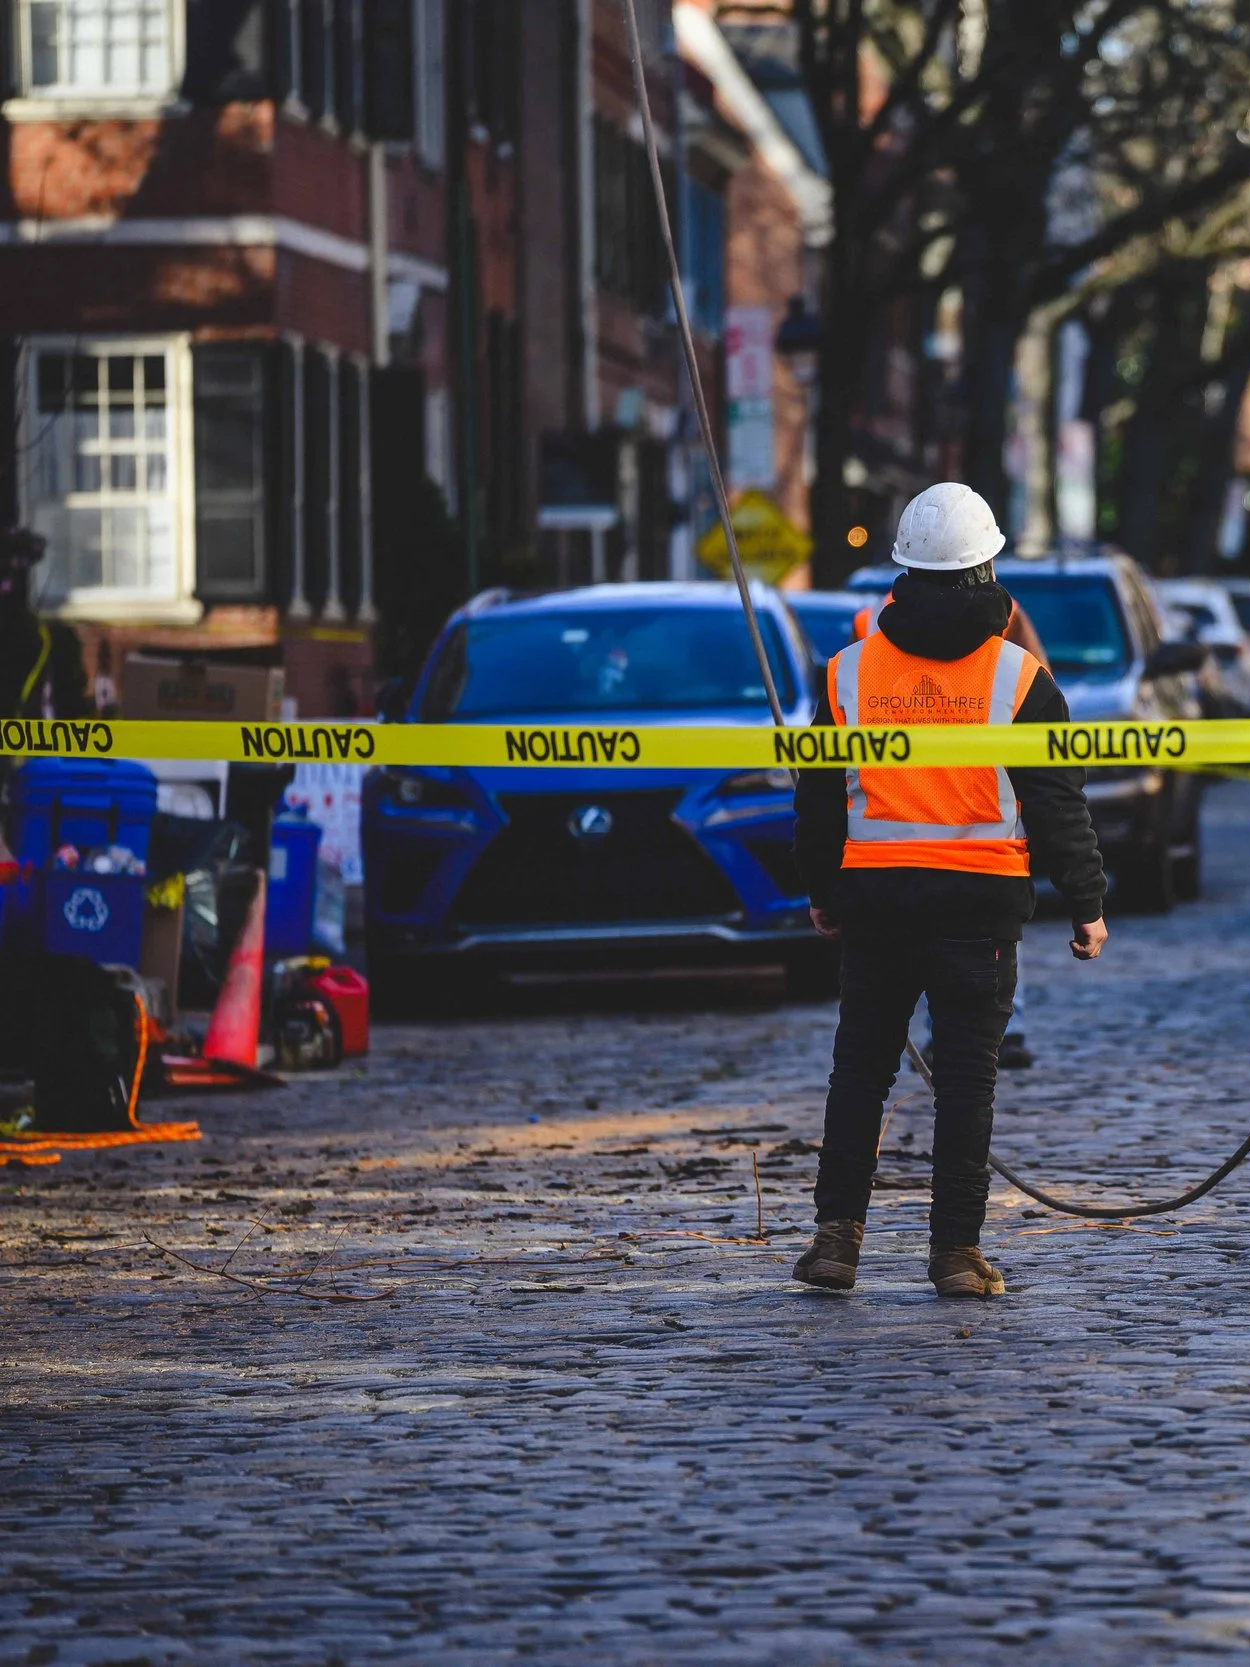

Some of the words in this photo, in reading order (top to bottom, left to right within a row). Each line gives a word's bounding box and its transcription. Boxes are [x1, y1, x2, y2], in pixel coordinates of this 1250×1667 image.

[867, 696, 936, 709] GROUND
[939, 695, 985, 710] THREE
[0, 720, 113, 752] CAUTIO
[867, 717, 893, 725] DESIGN
[895, 717, 911, 725] THAT
[912, 717, 931, 725] LIVES
[931, 717, 950, 725] WITH
[952, 717, 965, 725] THE
[241, 727, 375, 758] CAUTION
[505, 731, 641, 762] CAUTION
[774, 731, 911, 763] CAUTION
[1047, 726, 1186, 760] CAUTION
